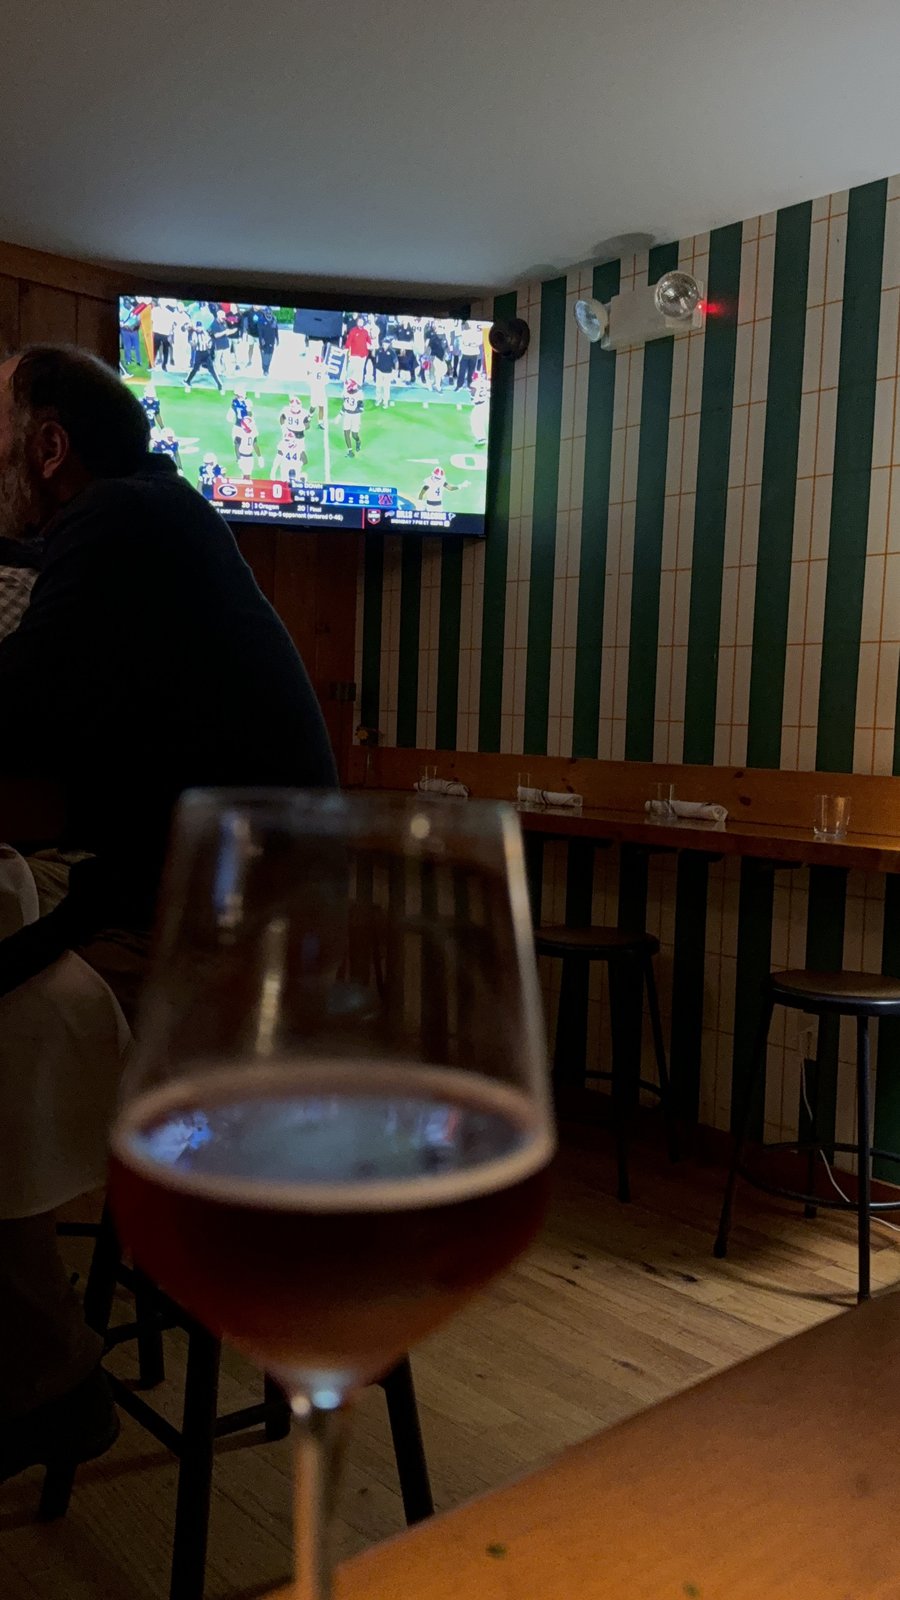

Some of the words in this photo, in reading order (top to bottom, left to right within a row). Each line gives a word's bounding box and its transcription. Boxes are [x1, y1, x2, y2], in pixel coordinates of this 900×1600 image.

[287, 417, 299, 425] 94
[285, 452, 297, 460] 44
[272, 483, 283, 499] 0
[329, 487, 345, 502] 10
